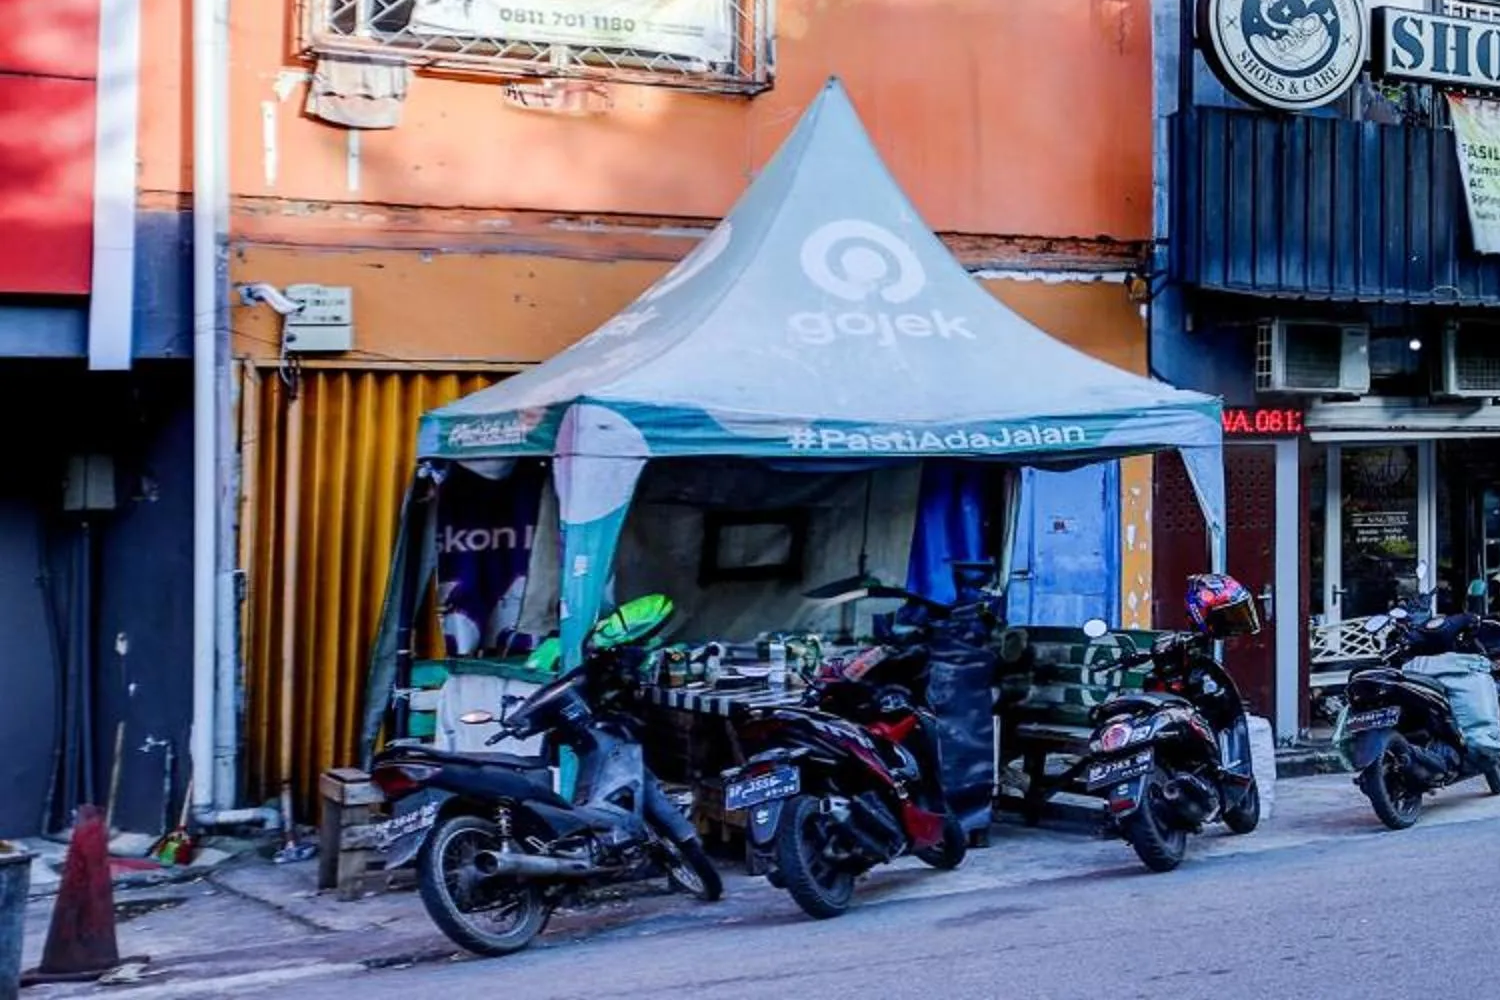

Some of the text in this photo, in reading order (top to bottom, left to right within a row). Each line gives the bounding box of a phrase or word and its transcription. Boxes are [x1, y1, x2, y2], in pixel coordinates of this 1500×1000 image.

[499, 7, 545, 25] 0811
[552, 11, 586, 28] 701
[592, 15, 636, 33] 1180
[1236, 49, 1341, 94] SHOES & CARE
[788, 309, 977, 346] gojek
[787, 424, 1087, 452] #PastiAdaJalan
